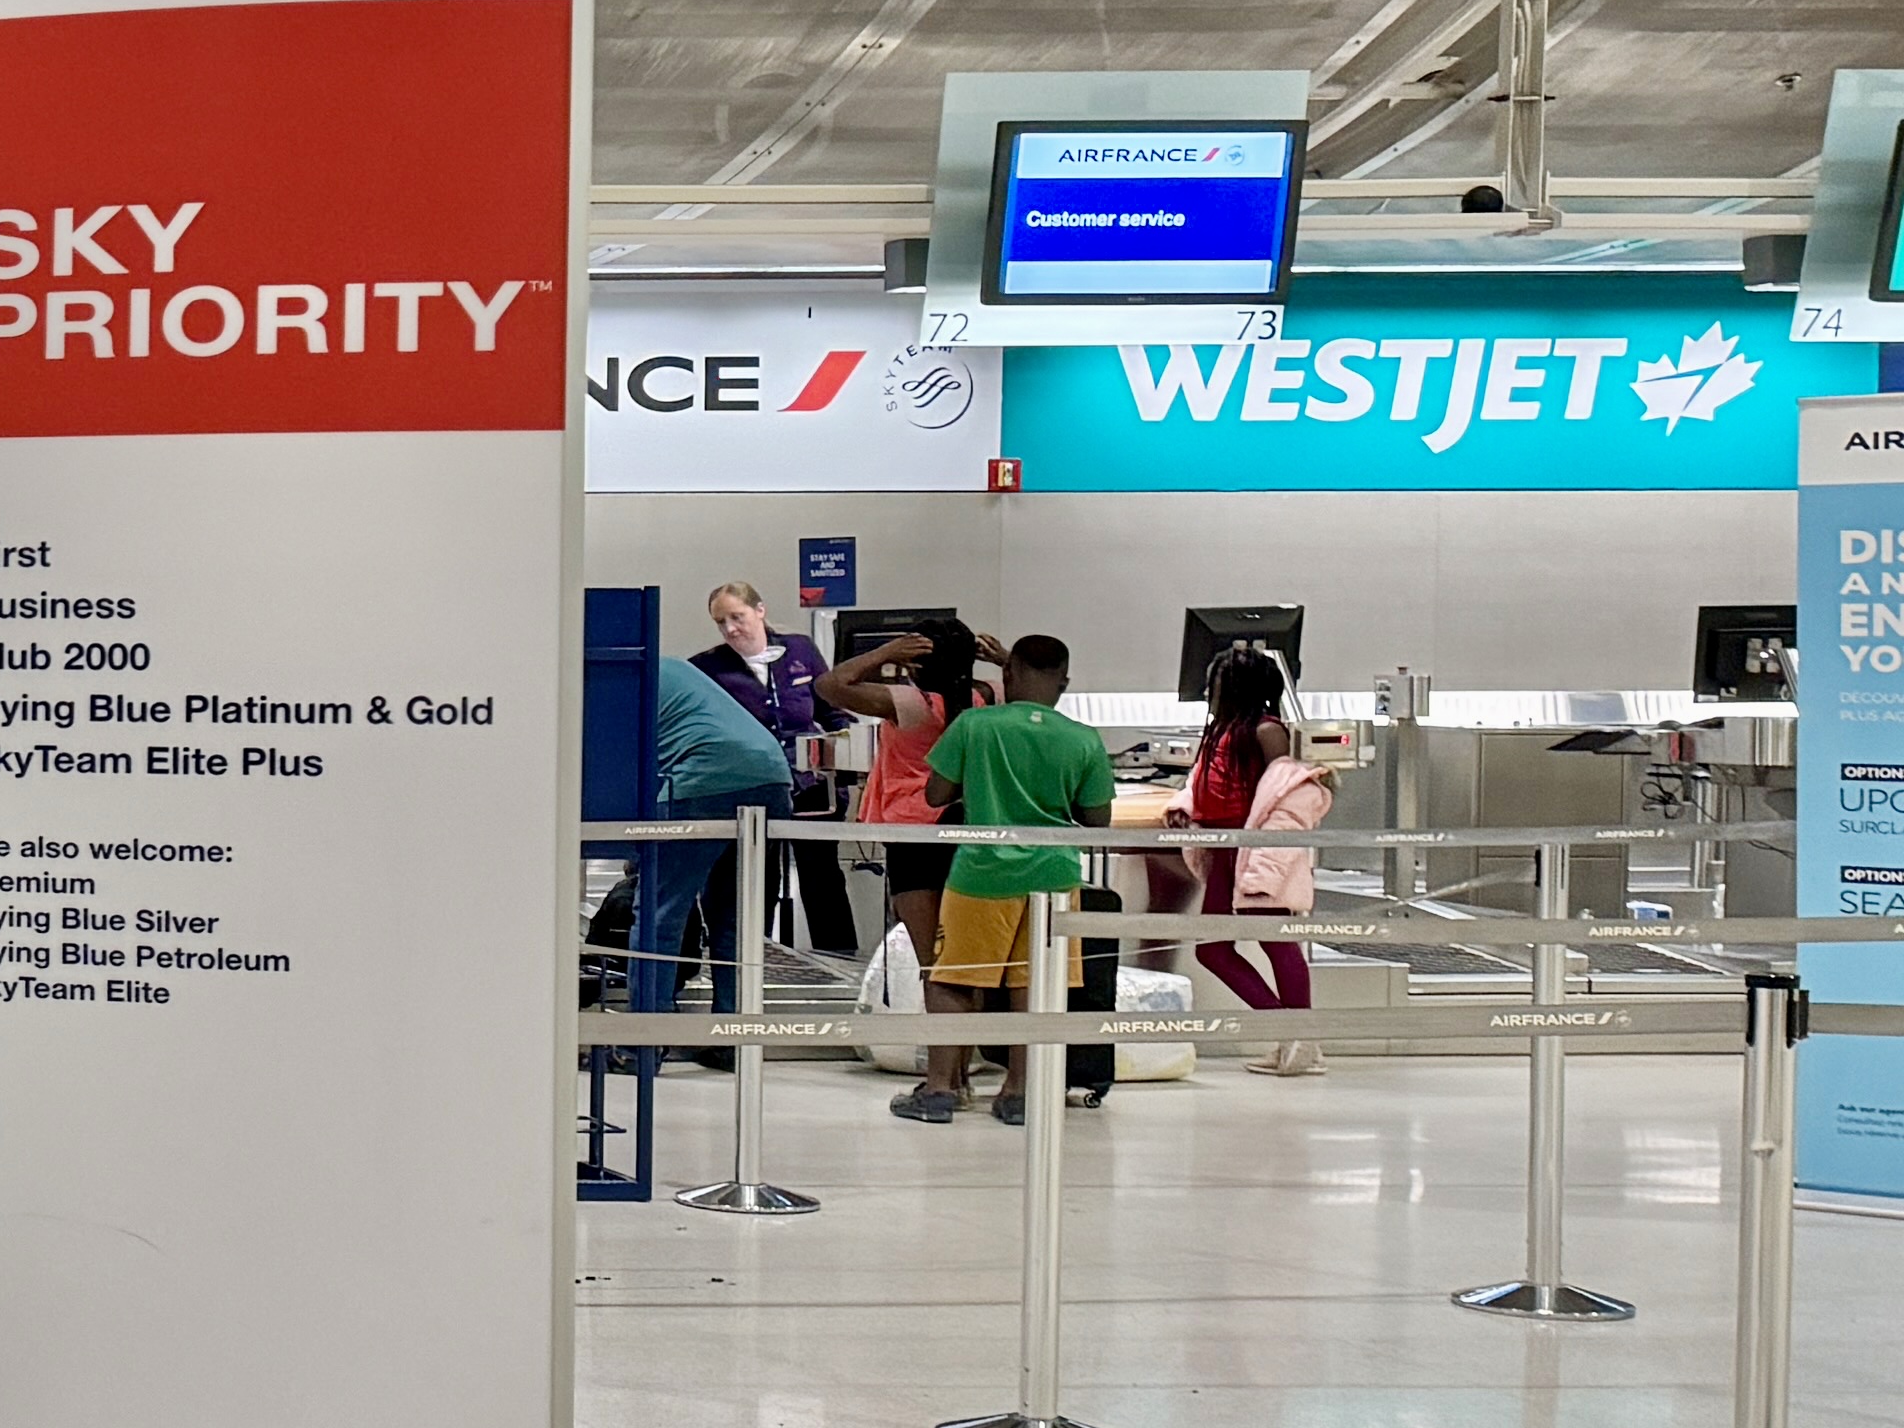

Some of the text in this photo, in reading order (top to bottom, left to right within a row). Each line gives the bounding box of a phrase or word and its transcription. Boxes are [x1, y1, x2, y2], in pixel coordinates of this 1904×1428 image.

[1058, 147, 1198, 163] AIRFRANCE
[1026, 209, 1186, 228] Customer service
[928, 312, 970, 343] 72
[1236, 309, 1278, 341] 73
[1802, 307, 1843, 338] 74
[1118, 336, 1628, 454] WESTJET
[1840, 529, 1904, 564] DI
[1840, 572, 1871, 595] A
[63, 642, 152, 672] 2000
[1839, 644, 1904, 673] YO
[88, 693, 172, 723] Blue
[185, 695, 353, 725] Platinum
[366, 696, 395, 726] &
[405, 695, 494, 726] Gold
[145, 745, 229, 776] Elite
[241, 747, 324, 777] Plus
[1844, 766, 1904, 779] OPTION
[624, 826, 684, 835] AIRFRANCE
[938, 829, 998, 839] AIRFRANCE
[1594, 829, 1657, 839] AIRFRANCE
[1838, 819, 1904, 835] SURCL
[1157, 833, 1219, 842] AIRFRANCE
[1374, 833, 1435, 843] AIRFRANCE
[19, 834, 80, 860] also
[89, 838, 234, 863] welcome:
[1844, 869, 1904, 883] OPTION
[61, 907, 126, 932] Blue
[134, 909, 220, 935] Silver
[1279, 923, 1363, 936] AIRFRANCE
[1588, 925, 1672, 937] AIRFRANCE
[60, 942, 126, 967] Blue
[135, 945, 291, 972] Petroleum
[106, 979, 171, 1004] Elite
[709, 1021, 816, 1036] AIRFRANCE
[1098, 1019, 1206, 1035] AIRFRANCE
[1490, 1012, 1596, 1028] AIRFRANCE
